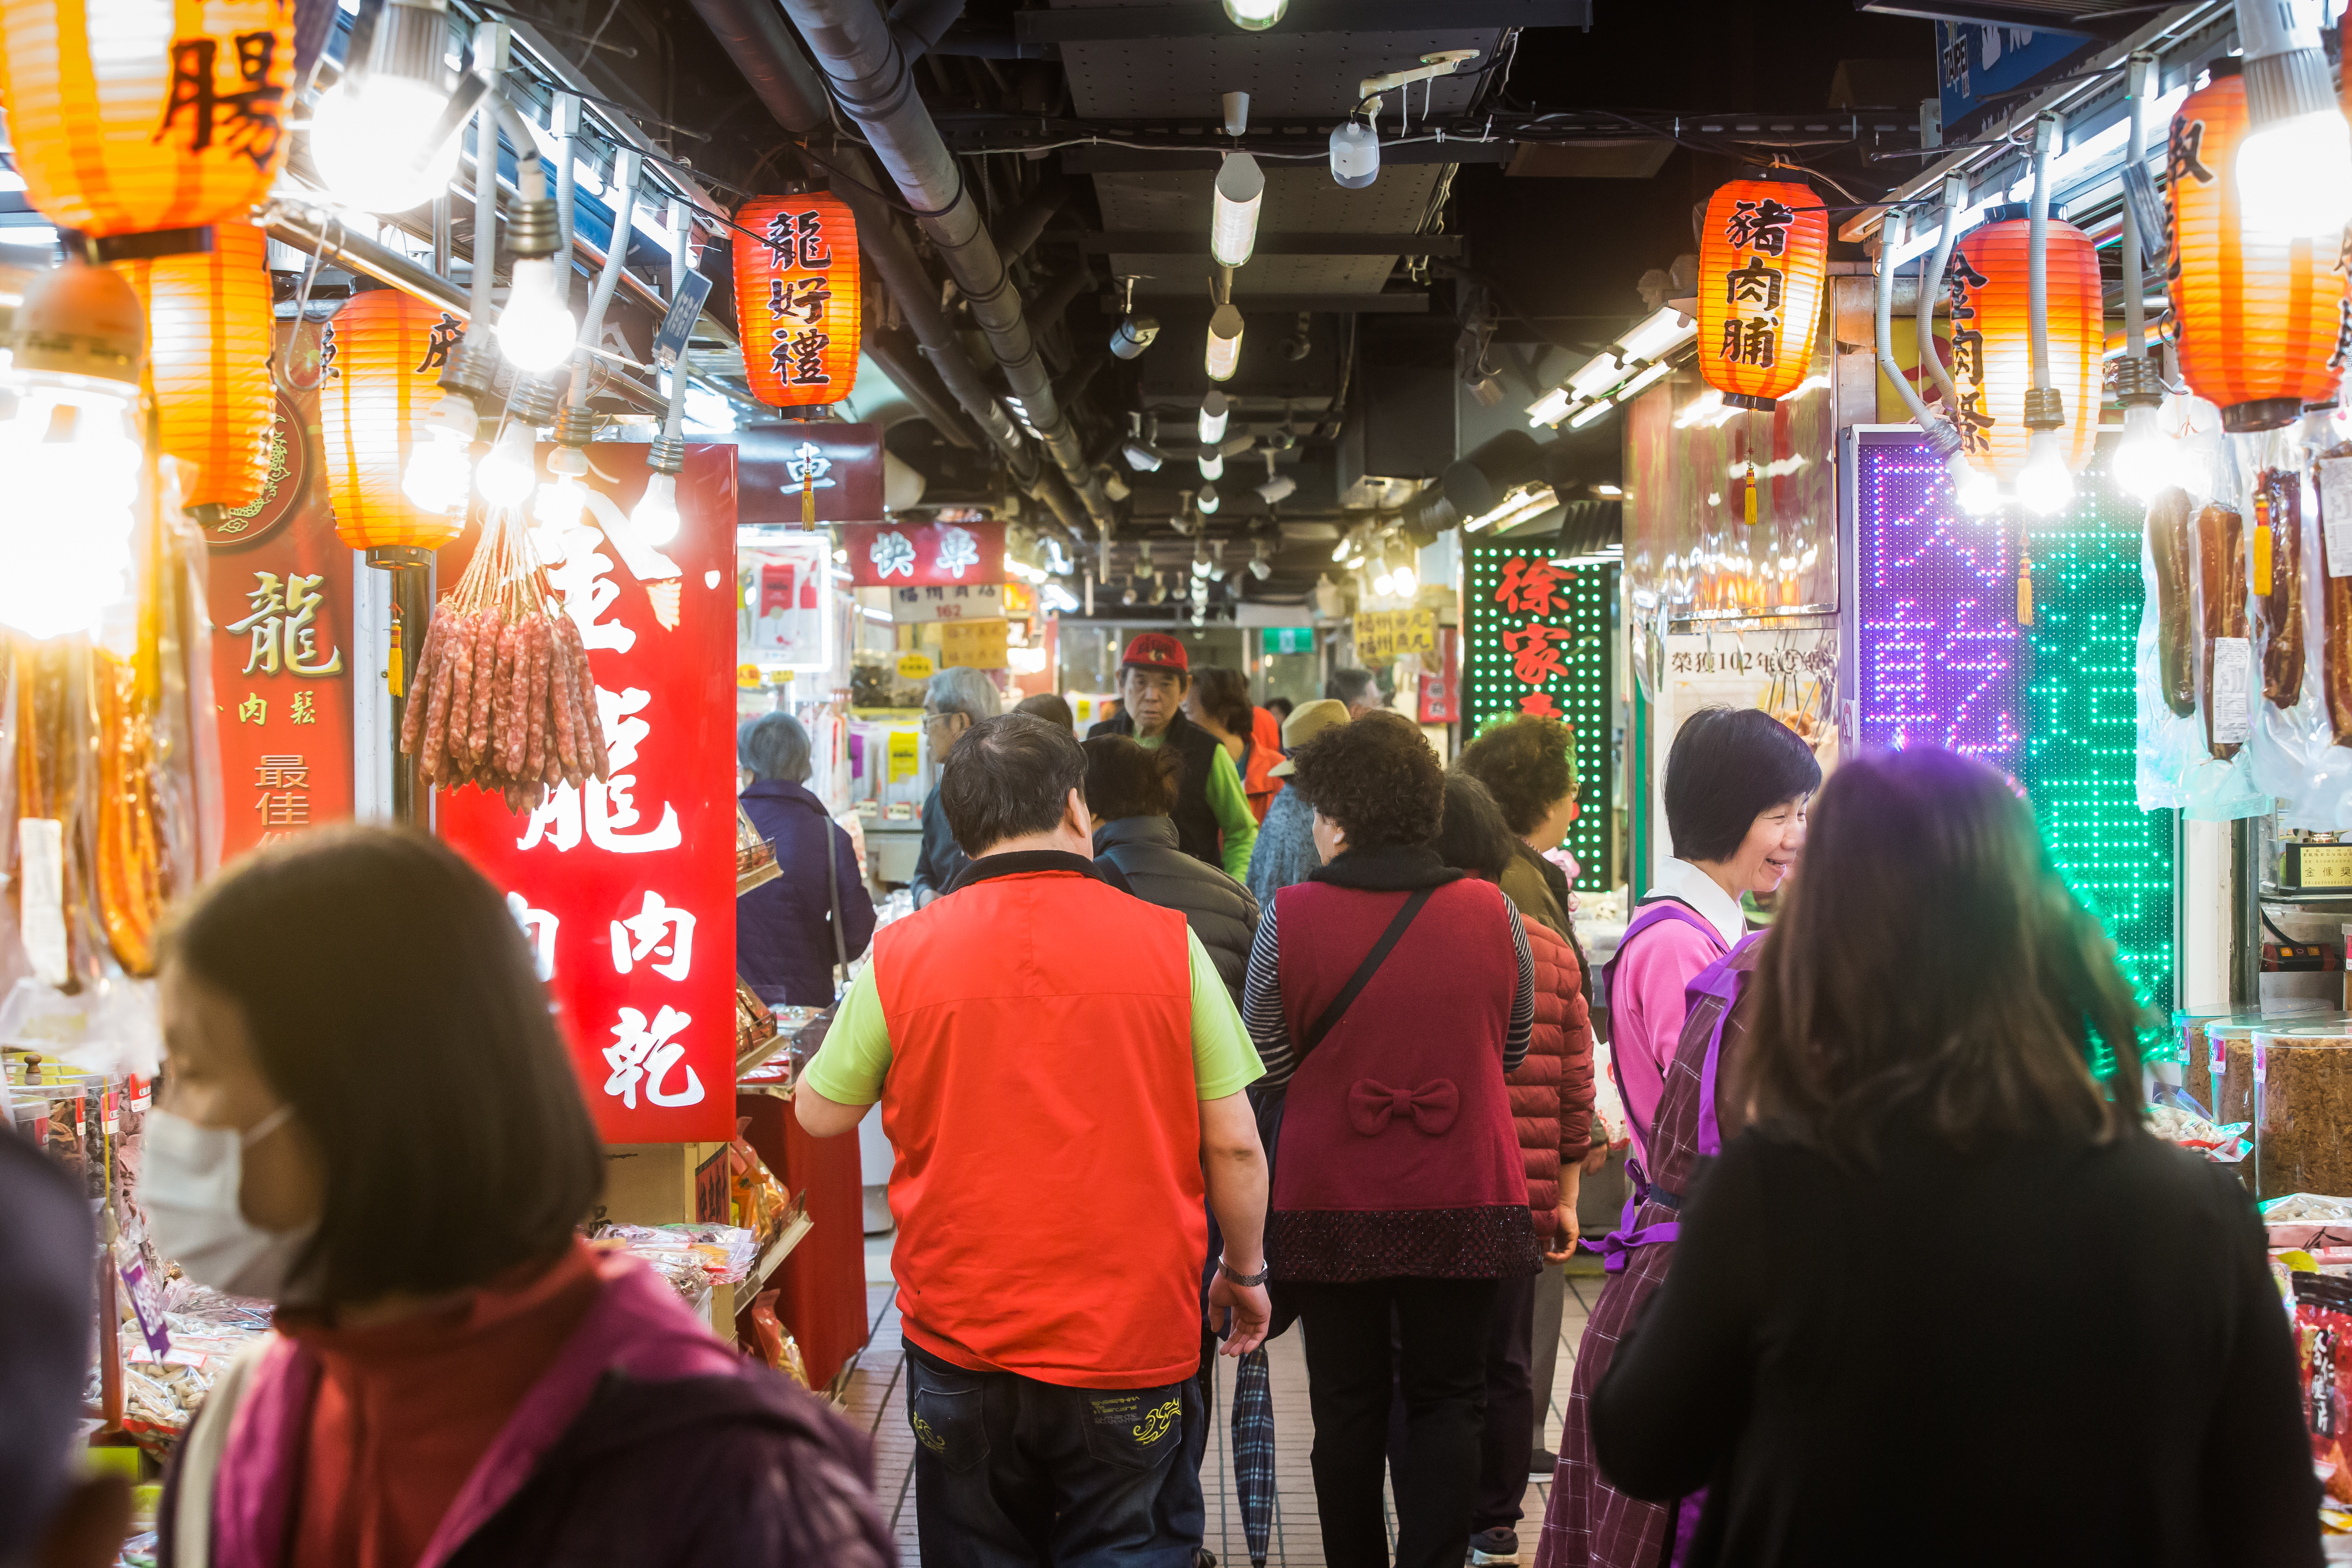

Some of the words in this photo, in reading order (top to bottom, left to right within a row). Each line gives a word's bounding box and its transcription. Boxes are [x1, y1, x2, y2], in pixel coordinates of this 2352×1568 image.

[762, 210, 832, 386] 龍好禮
[1719, 198, 1794, 368] 豬肉脯
[780, 441, 836, 494] 車
[602, 890, 705, 1109] 肉乾
